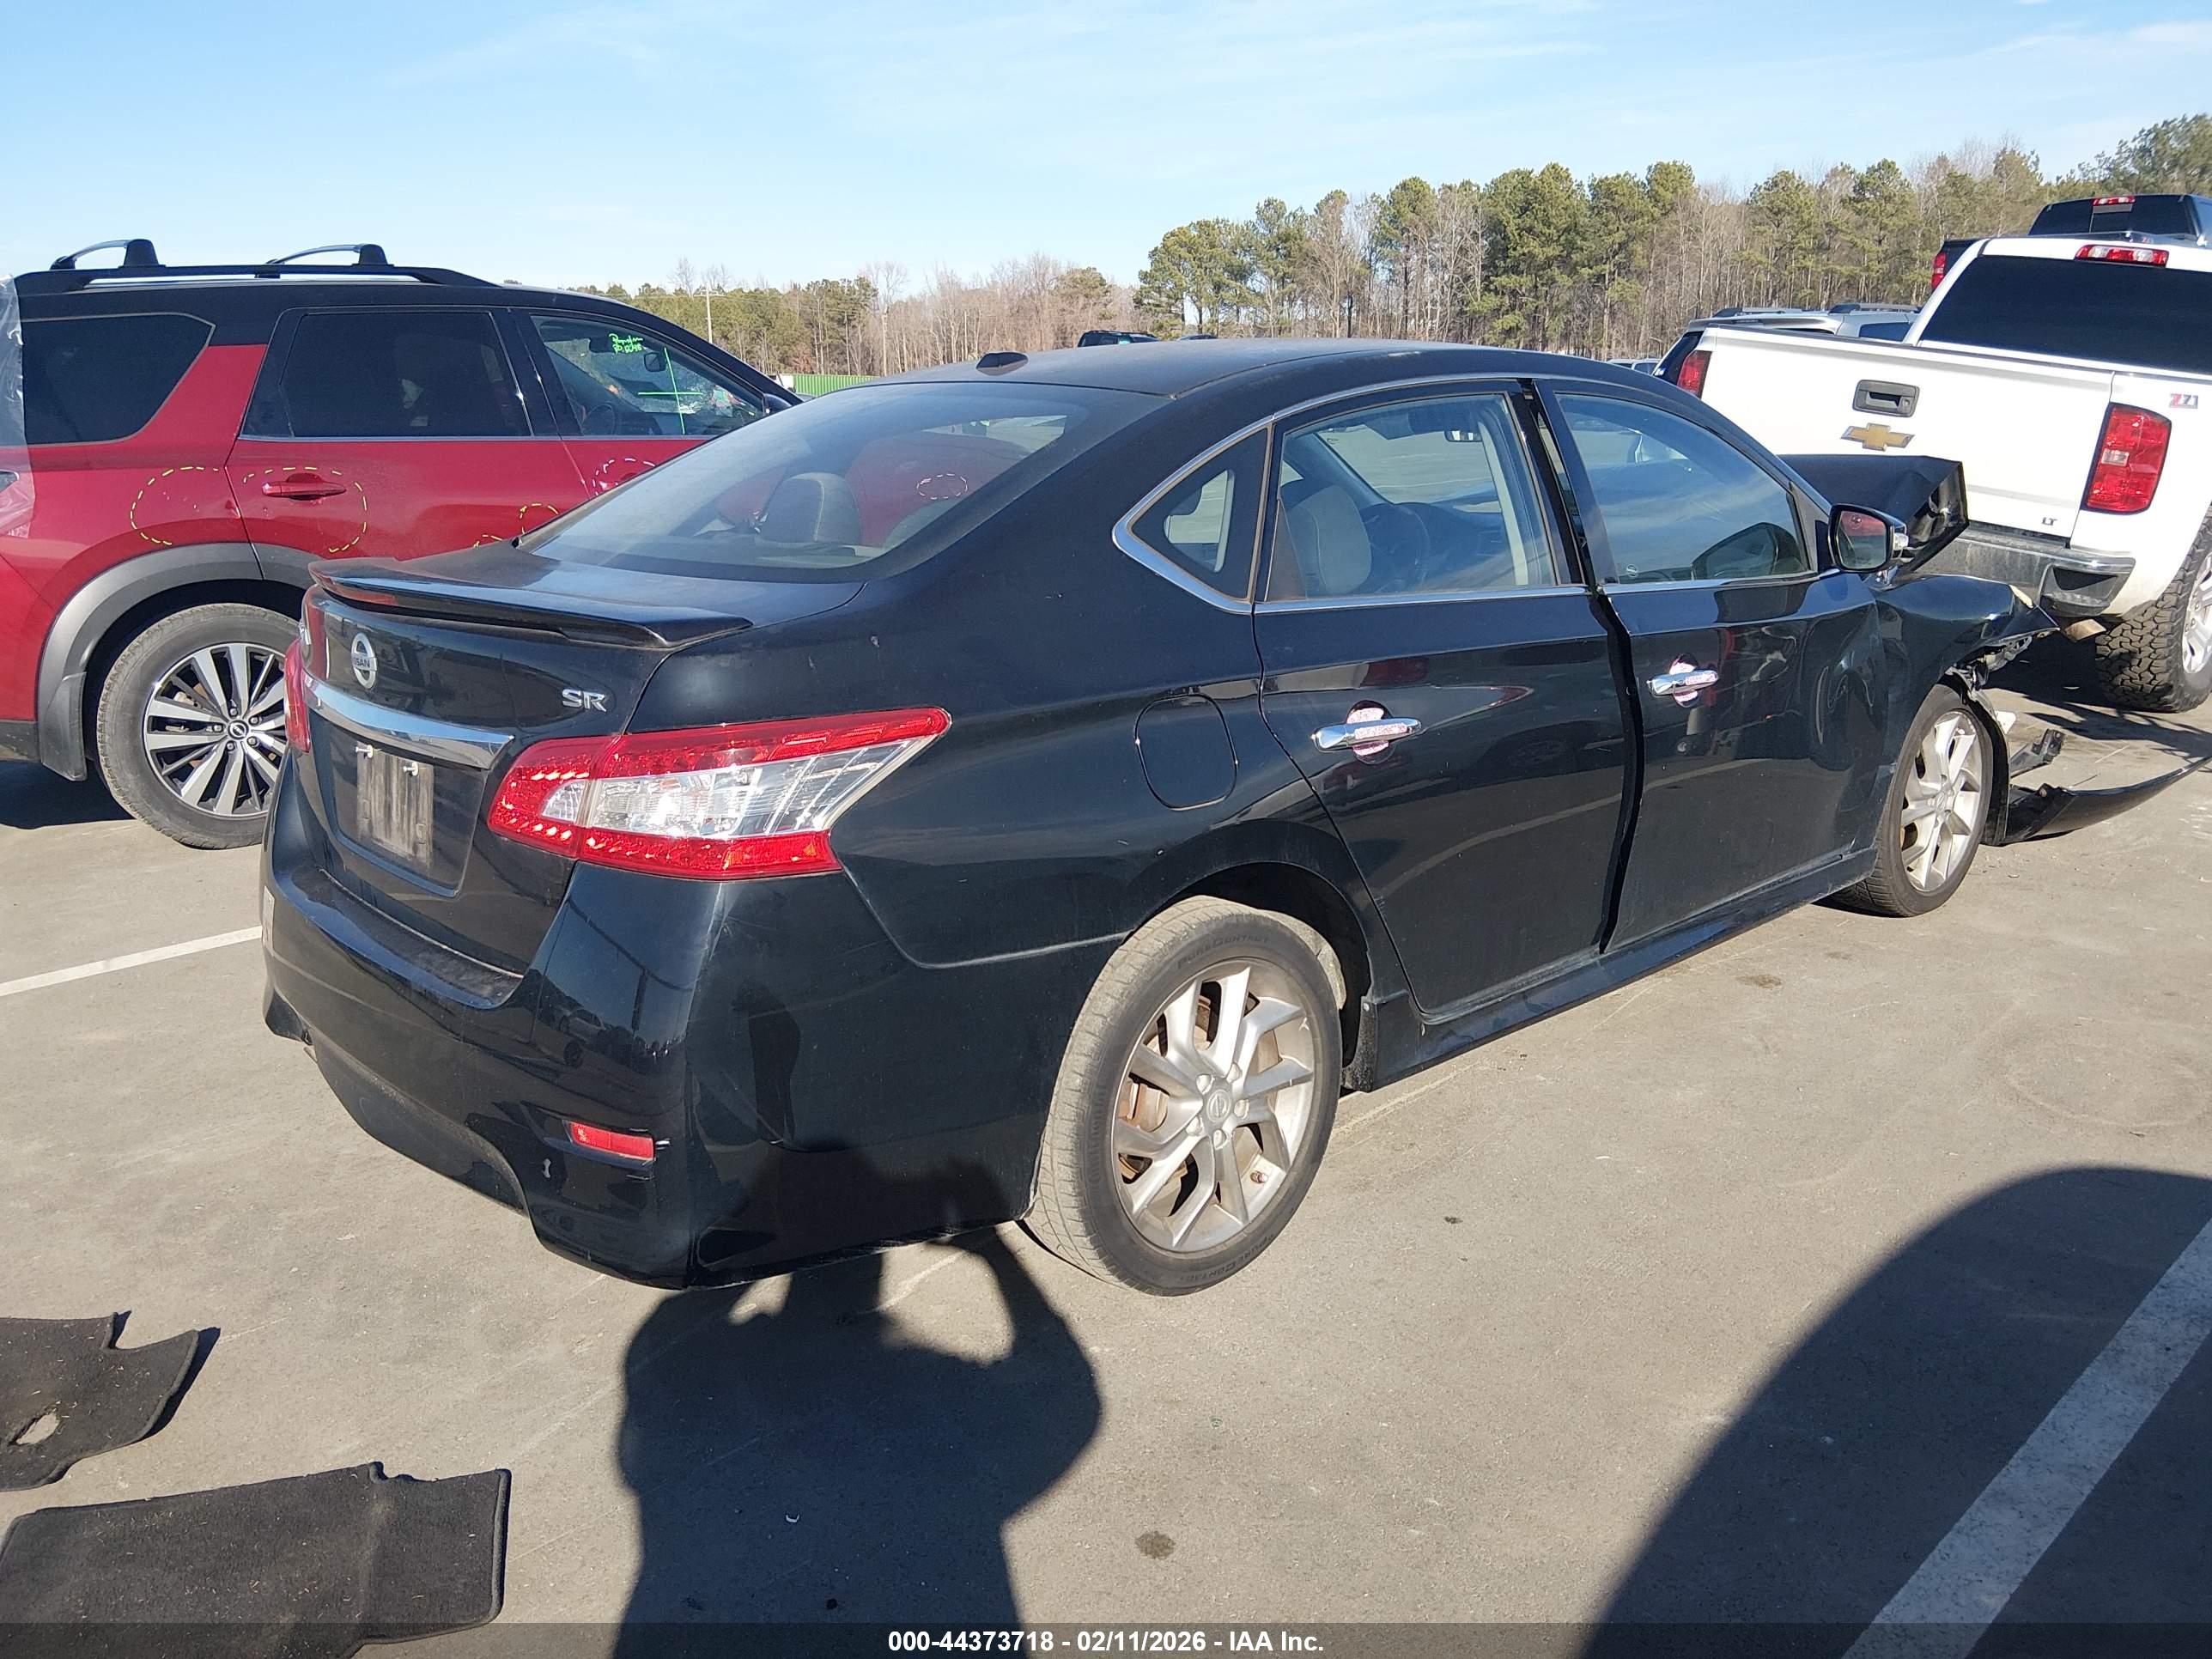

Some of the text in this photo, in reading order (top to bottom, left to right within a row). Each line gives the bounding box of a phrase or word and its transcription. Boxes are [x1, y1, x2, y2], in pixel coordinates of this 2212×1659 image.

[2170, 393, 2199, 409] Z71
[2041, 517, 2058, 526] LT
[562, 689, 607, 712] SR
